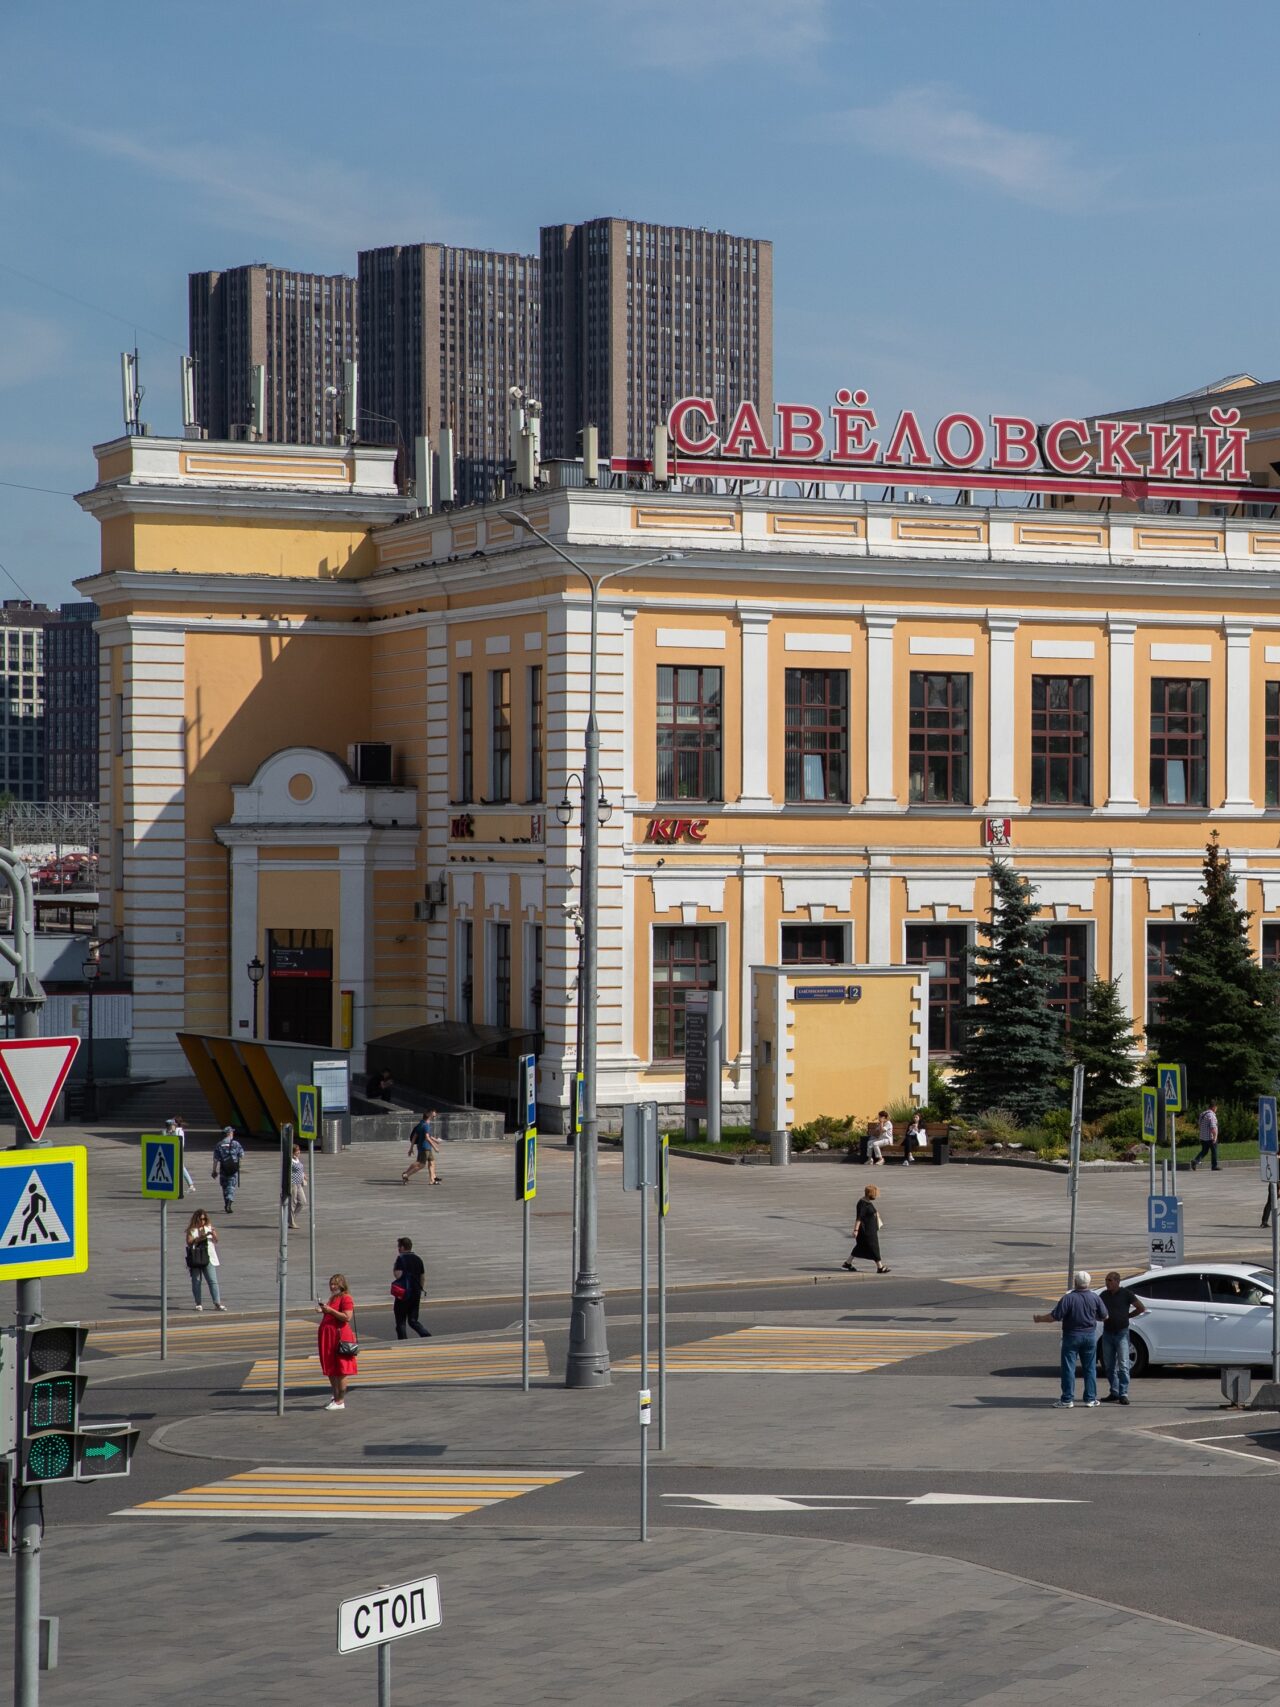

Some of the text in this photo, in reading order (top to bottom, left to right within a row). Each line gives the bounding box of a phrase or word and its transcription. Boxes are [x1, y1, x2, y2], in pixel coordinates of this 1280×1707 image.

[668, 388, 1250, 481] САВЁЛОВСКИЙ
[650, 819, 708, 840] KFC
[852, 988, 859, 997] 2
[1151, 1199, 1168, 1229] P
[354, 1588, 427, 1639] СТОП
